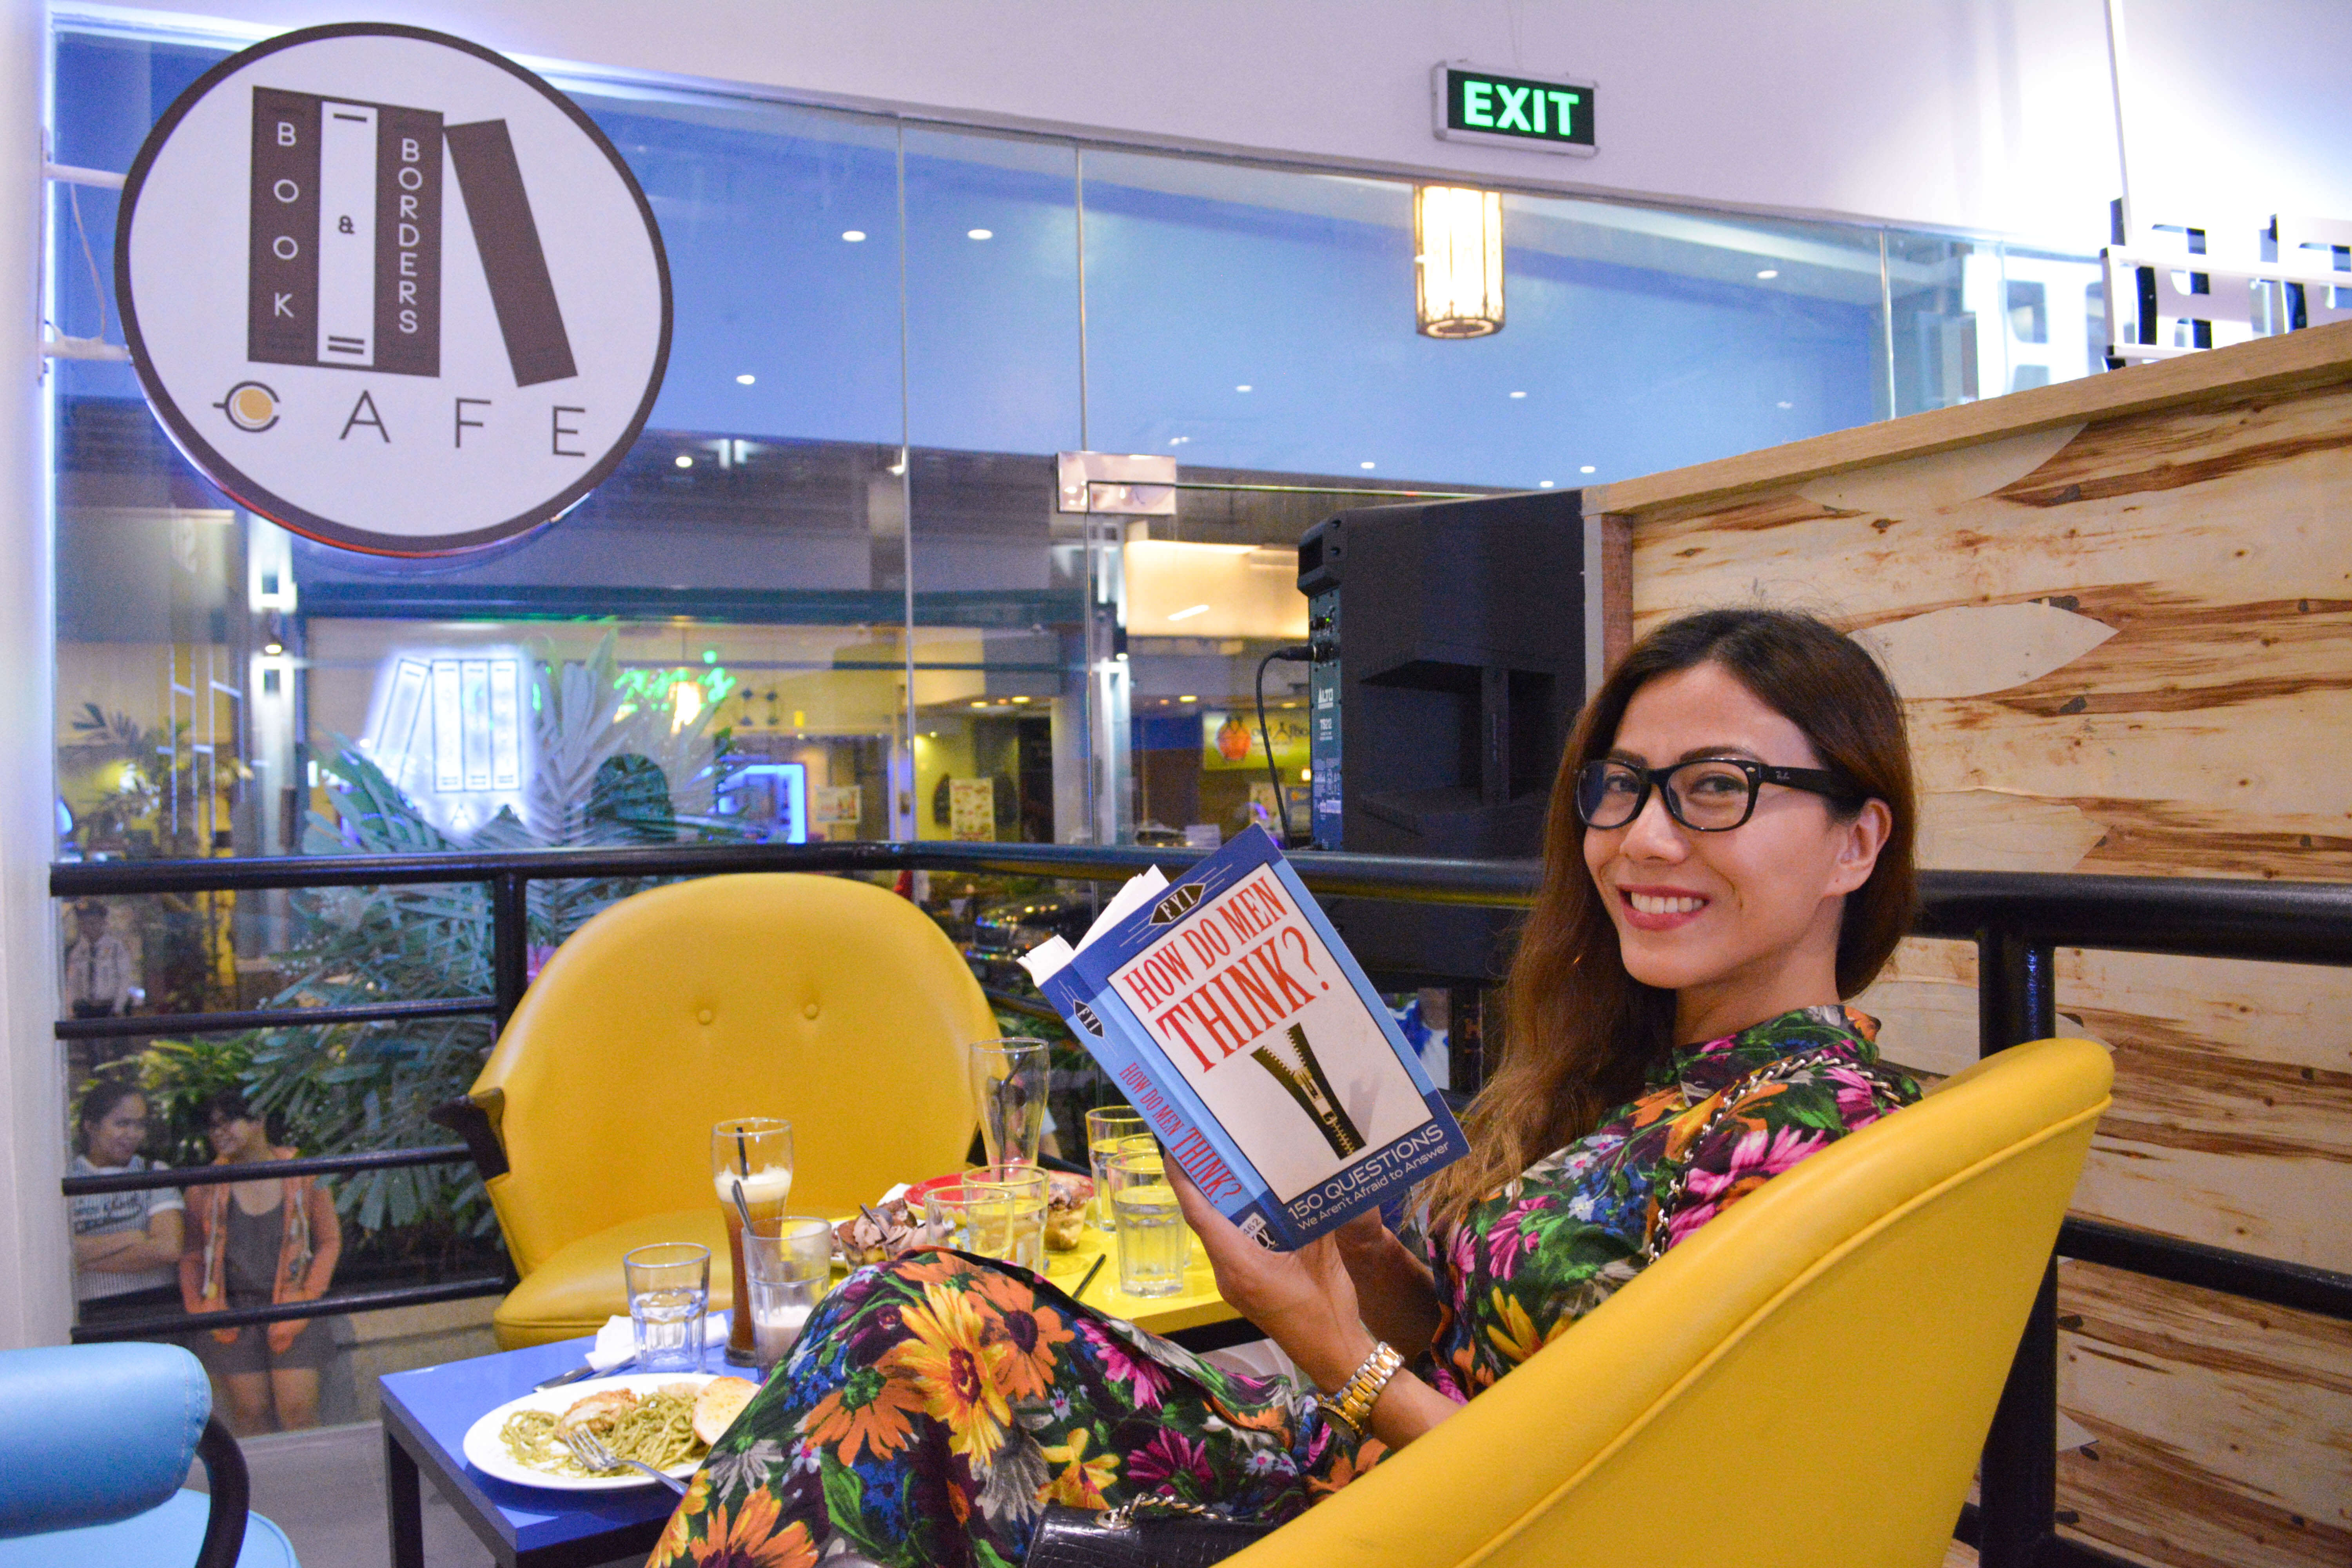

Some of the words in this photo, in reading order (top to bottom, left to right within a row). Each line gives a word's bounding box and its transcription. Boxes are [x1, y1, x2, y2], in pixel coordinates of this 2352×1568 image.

[1464, 81, 1579, 136] EXIT
[274, 122, 299, 318] BOOK
[338, 215, 355, 234] &
[398, 138, 423, 334] BORDERS
[214, 380, 585, 457] CAFE
[1122, 940, 1194, 1013] HOW
[1180, 918, 1231, 971] DO
[1216, 876, 1288, 946] MEN
[1155, 926, 1329, 1073] THINK?
[1119, 1062, 1152, 1094] HOW
[1139, 1088, 1164, 1111] DO
[1152, 1104, 1185, 1137] MEN
[1171, 1126, 1242, 1204] THINK?
[1287, 1193, 1323, 1220] 150
[1325, 1124, 1444, 1200] QUESTIONS
[1297, 1216, 1318, 1230] We
[1319, 1197, 1352, 1221] Aren't
[1354, 1176, 1389, 1202] Afraid
[1389, 1169, 1403, 1181] to
[1405, 1141, 1449, 1173] Answer
